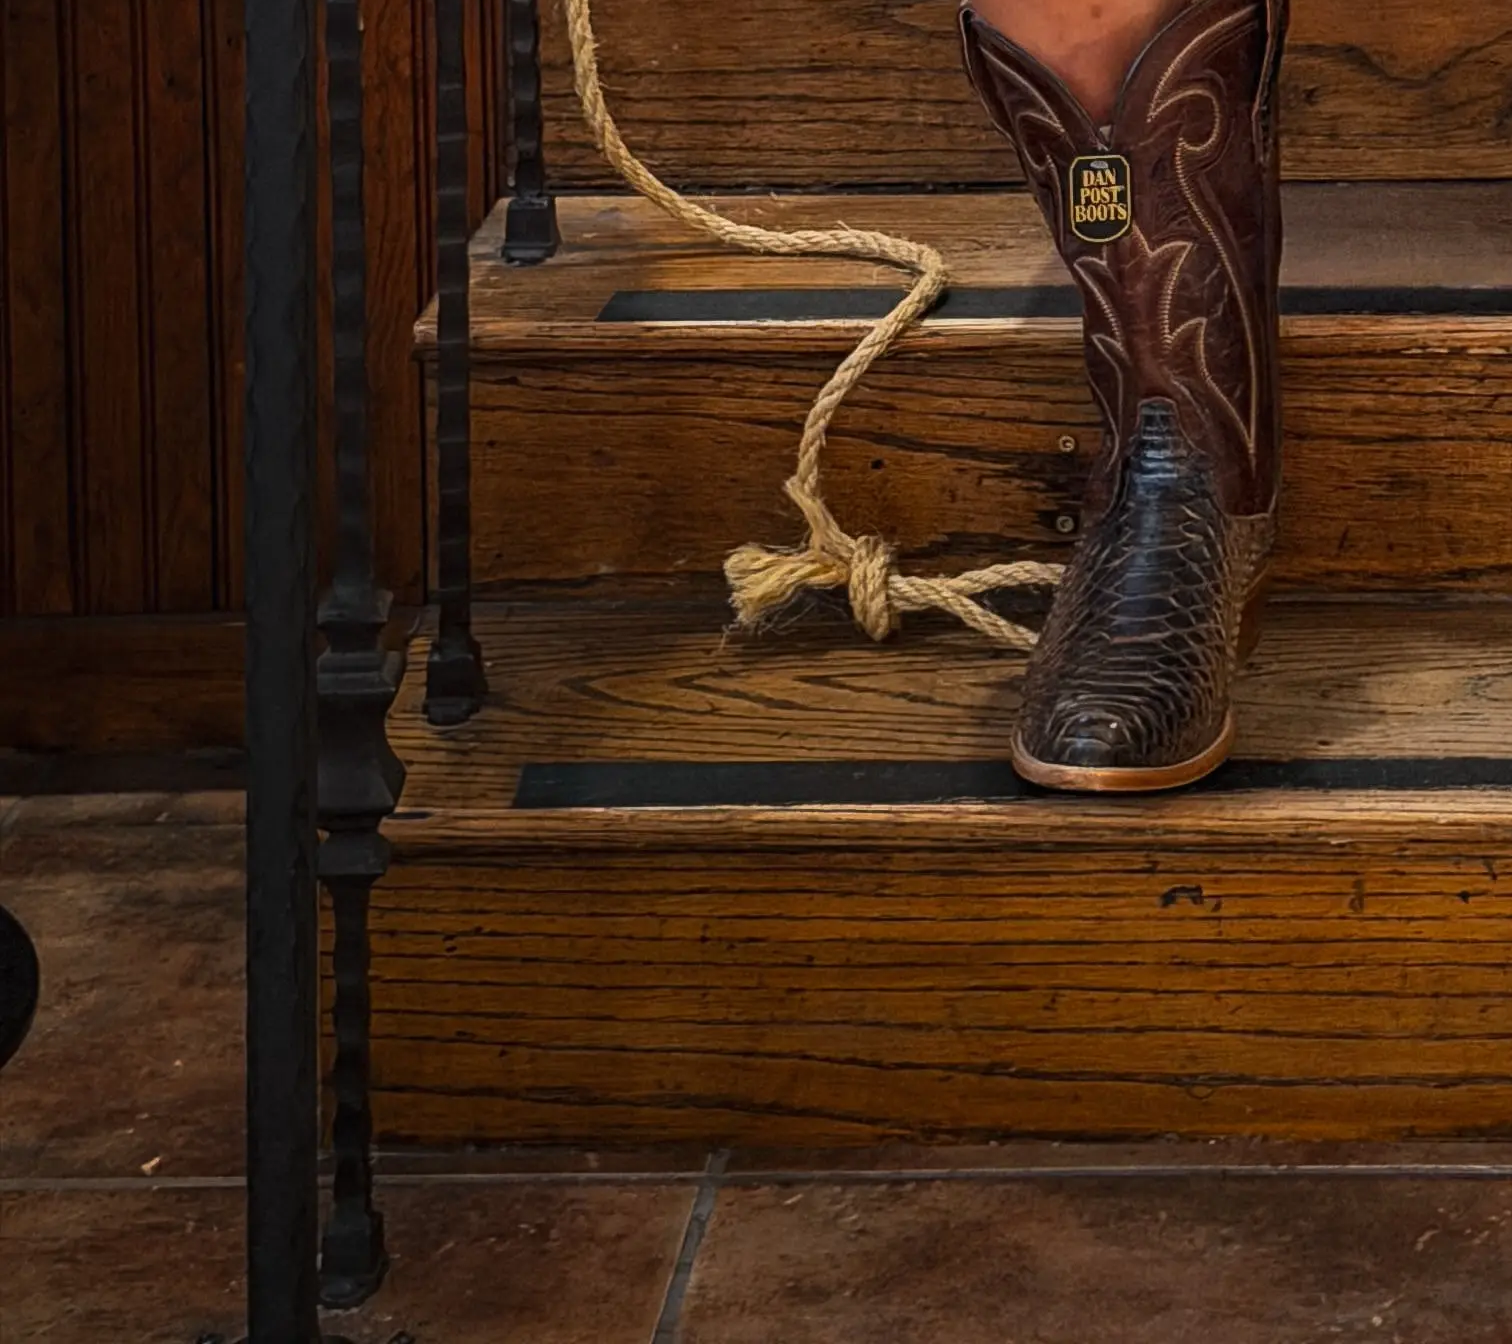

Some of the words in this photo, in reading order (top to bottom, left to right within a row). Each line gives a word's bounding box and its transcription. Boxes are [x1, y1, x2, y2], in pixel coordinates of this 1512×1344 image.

[1082, 168, 1117, 187] DAN
[1080, 186, 1119, 205] POST
[1074, 203, 1127, 223] BOOTS
